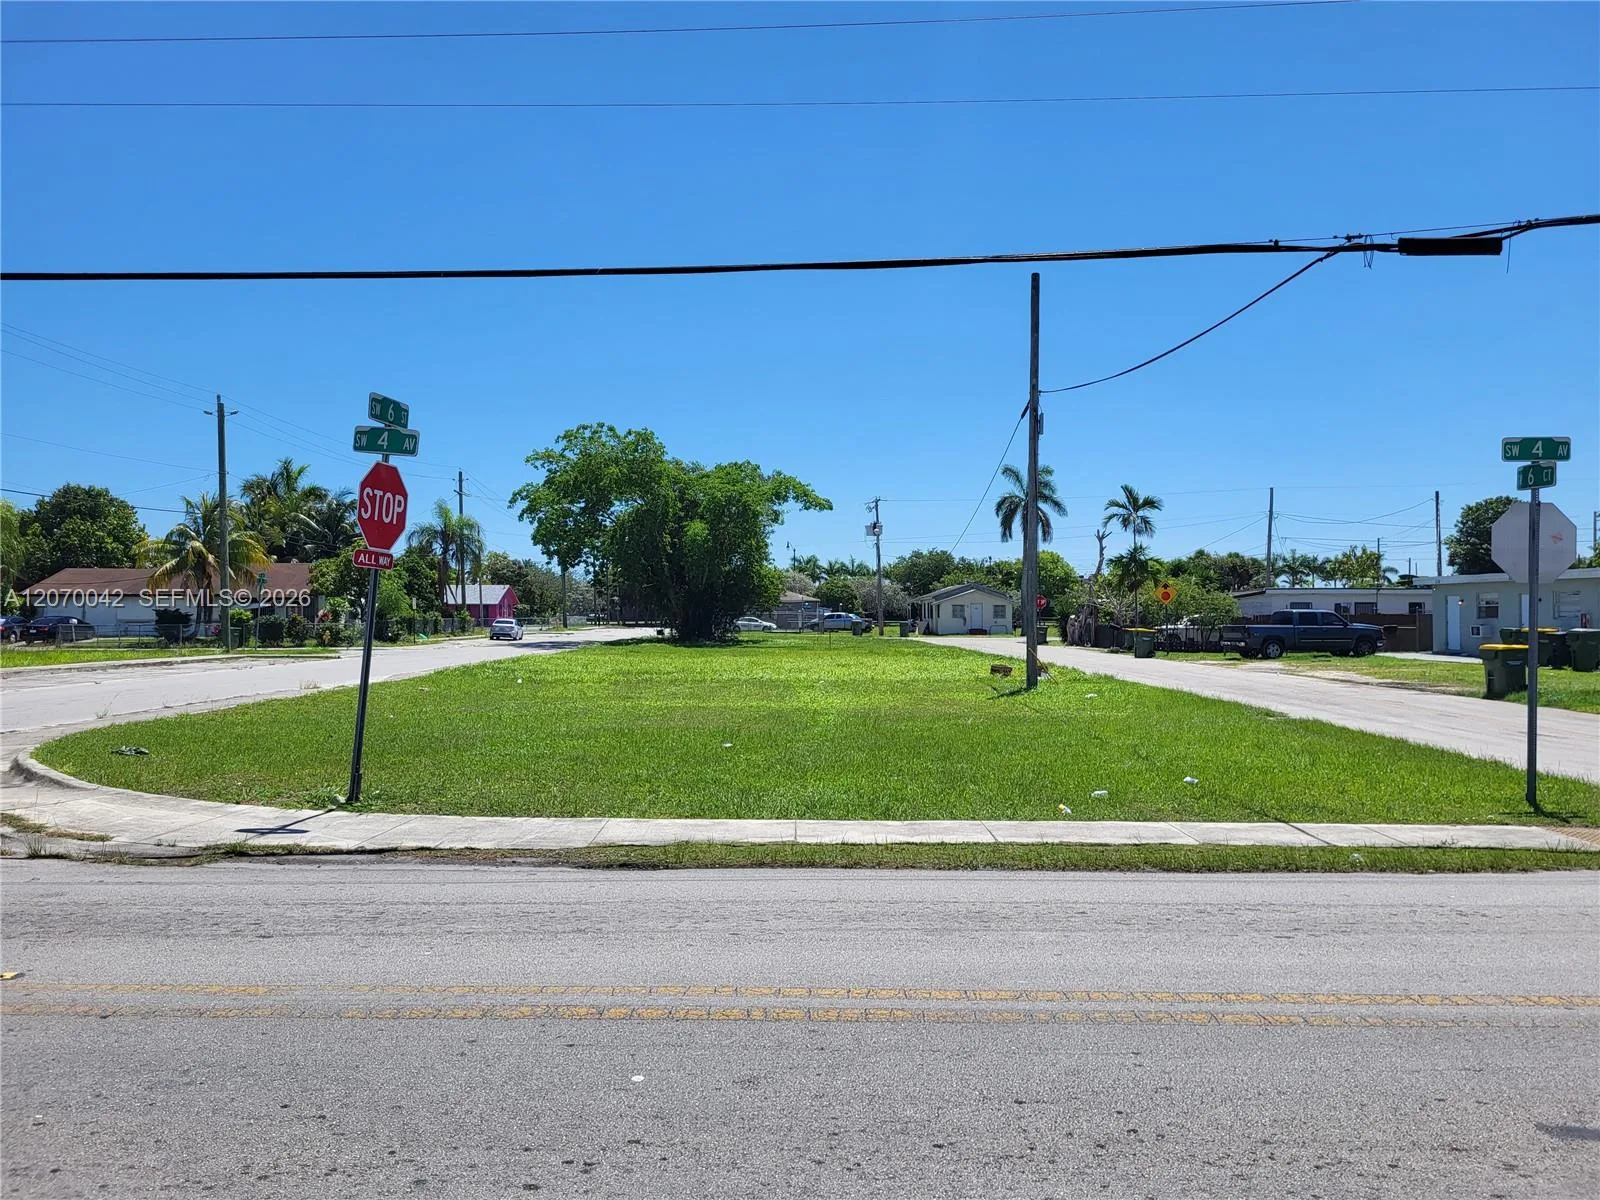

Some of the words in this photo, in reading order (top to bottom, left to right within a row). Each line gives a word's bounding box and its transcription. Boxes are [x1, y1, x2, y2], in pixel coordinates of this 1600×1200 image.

[372, 402, 380, 416] SW
[388, 404, 395, 422] 6
[401, 412, 408, 424] ST
[356, 434, 368, 448] SW
[378, 431, 388, 449] 4
[403, 438, 416, 451] AV
[1506, 445, 1520, 456] SW
[1532, 440, 1543, 457] 4
[1558, 445, 1568, 456] AV
[1528, 468, 1534, 485] 6
[1543, 470, 1552, 481] CT
[361, 487, 405, 524] STOP
[358, 553, 376, 565] ALL
[379, 555, 390, 567] WAY
